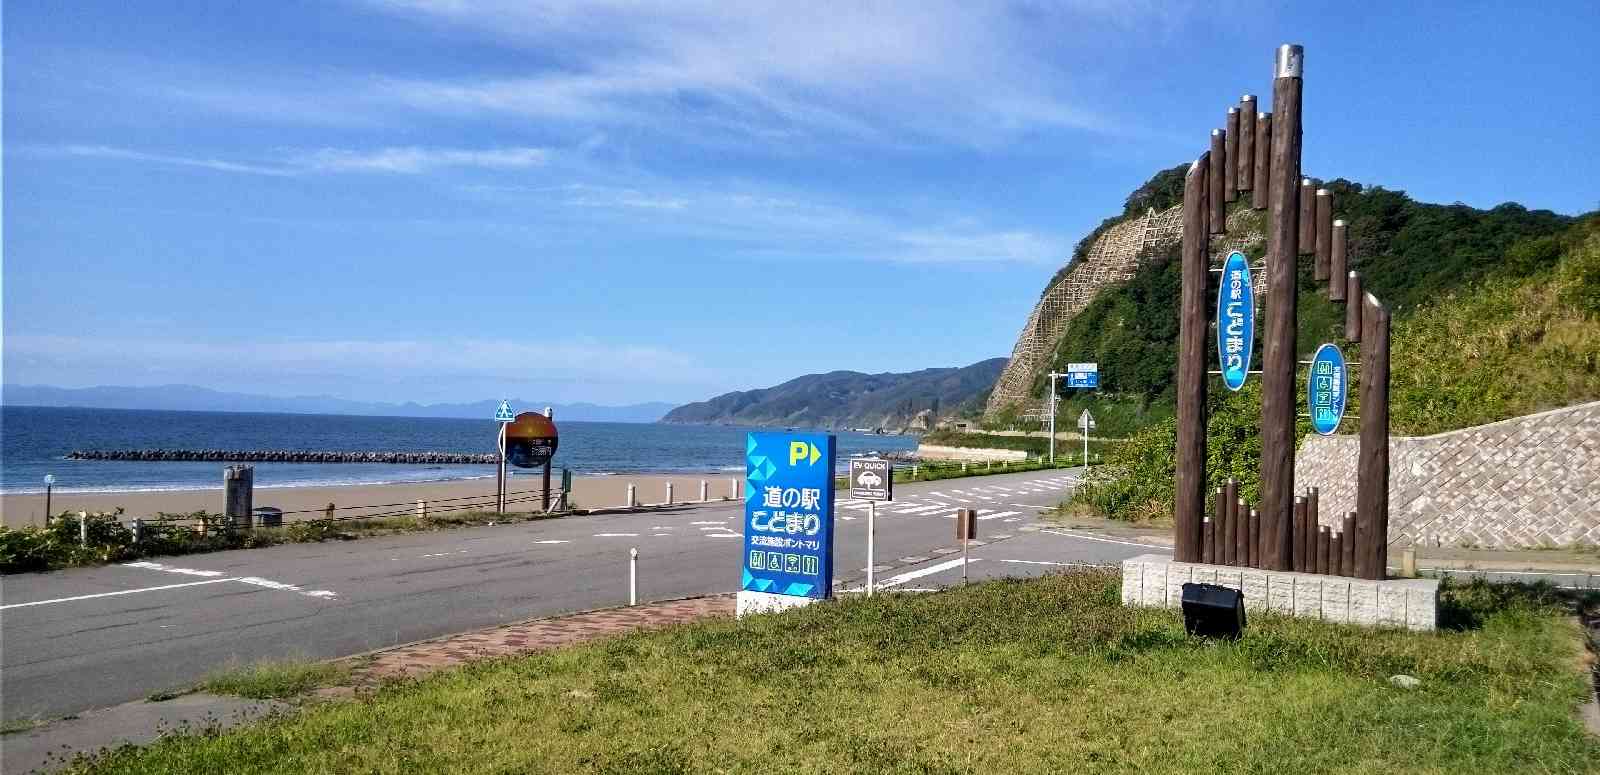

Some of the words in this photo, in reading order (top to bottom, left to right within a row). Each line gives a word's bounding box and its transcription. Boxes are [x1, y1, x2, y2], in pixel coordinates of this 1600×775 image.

[1231, 270, 1242, 299] 道の駅
[1226, 301, 1243, 370] こどまり
[790, 441, 809, 466] P
[853, 461, 862, 469] EV
[763, 486, 820, 510] 道の駅
[751, 510, 820, 536] こどまり
